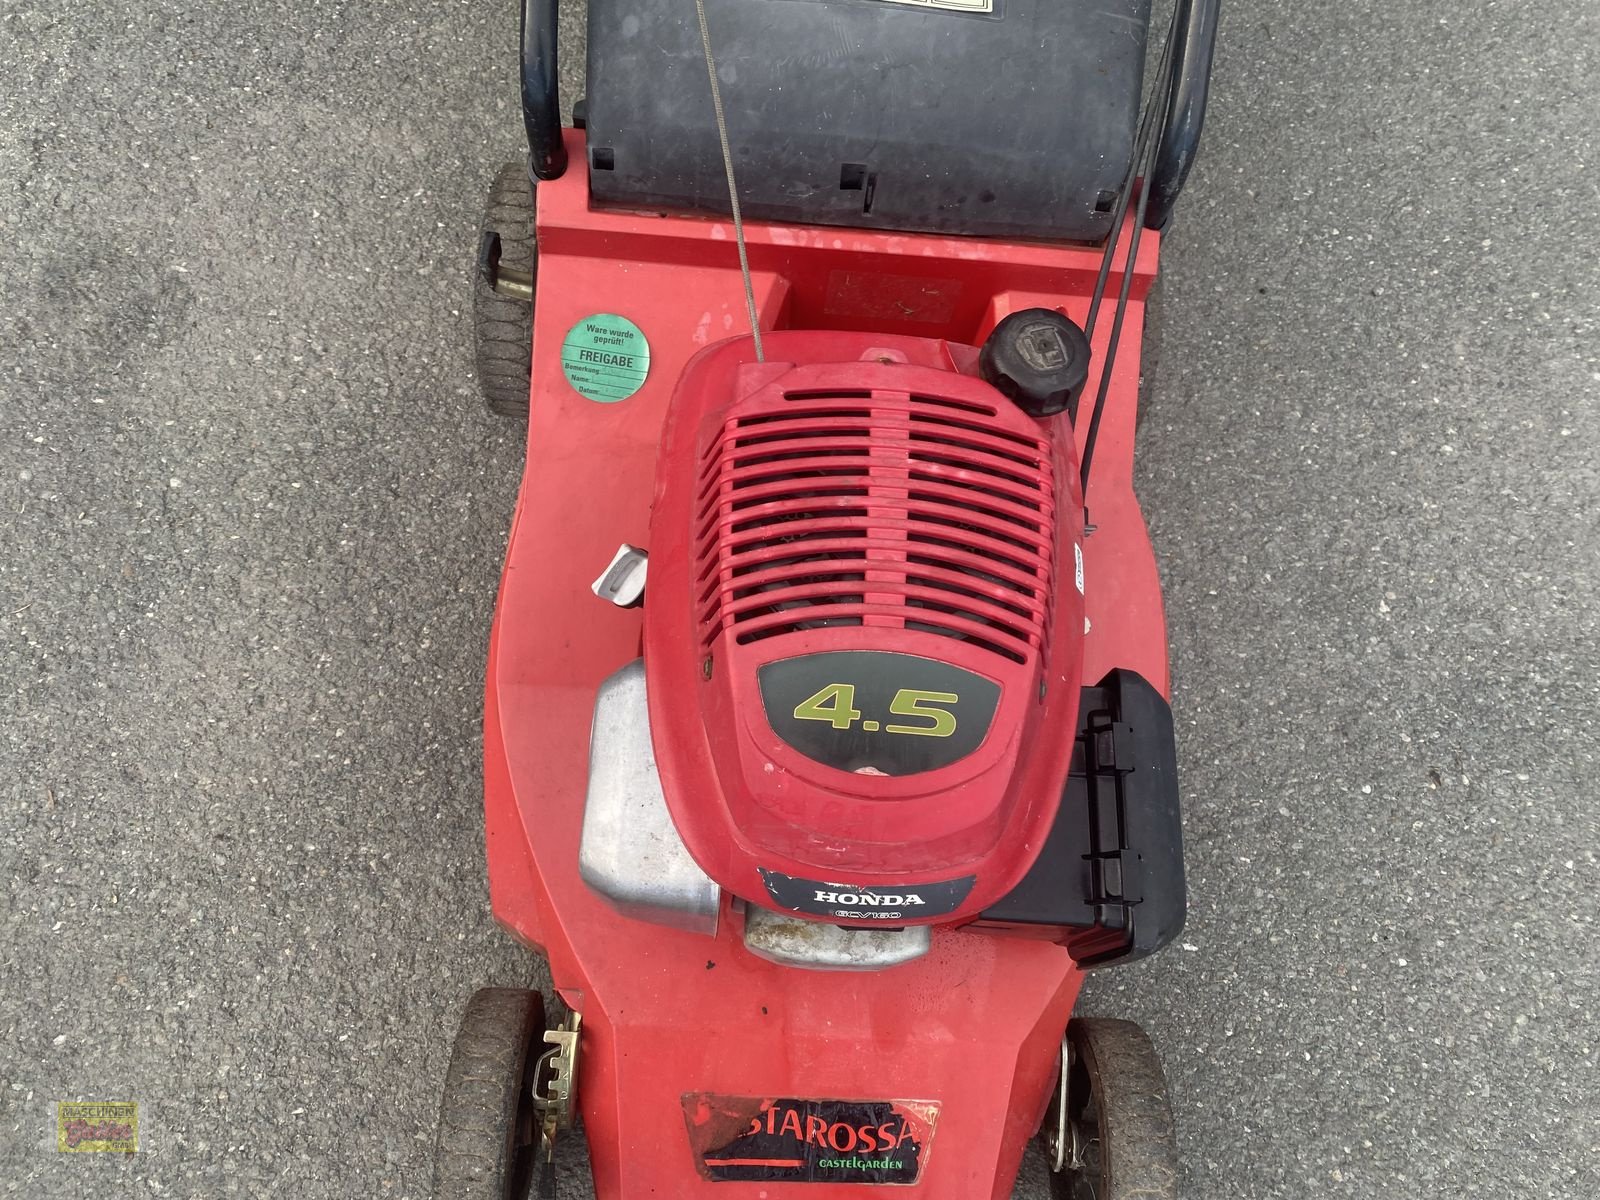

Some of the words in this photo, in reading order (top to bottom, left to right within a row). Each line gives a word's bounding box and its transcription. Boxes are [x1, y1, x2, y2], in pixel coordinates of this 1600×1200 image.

[586, 324, 608, 335] Ware
[609, 329, 634, 339] wurde
[593, 335, 625, 346] geprüft!
[579, 349, 634, 368] FREIGABE
[793, 683, 959, 738] 4.5
[813, 890, 926, 907] HONDA
[835, 910, 902, 919] GCV160
